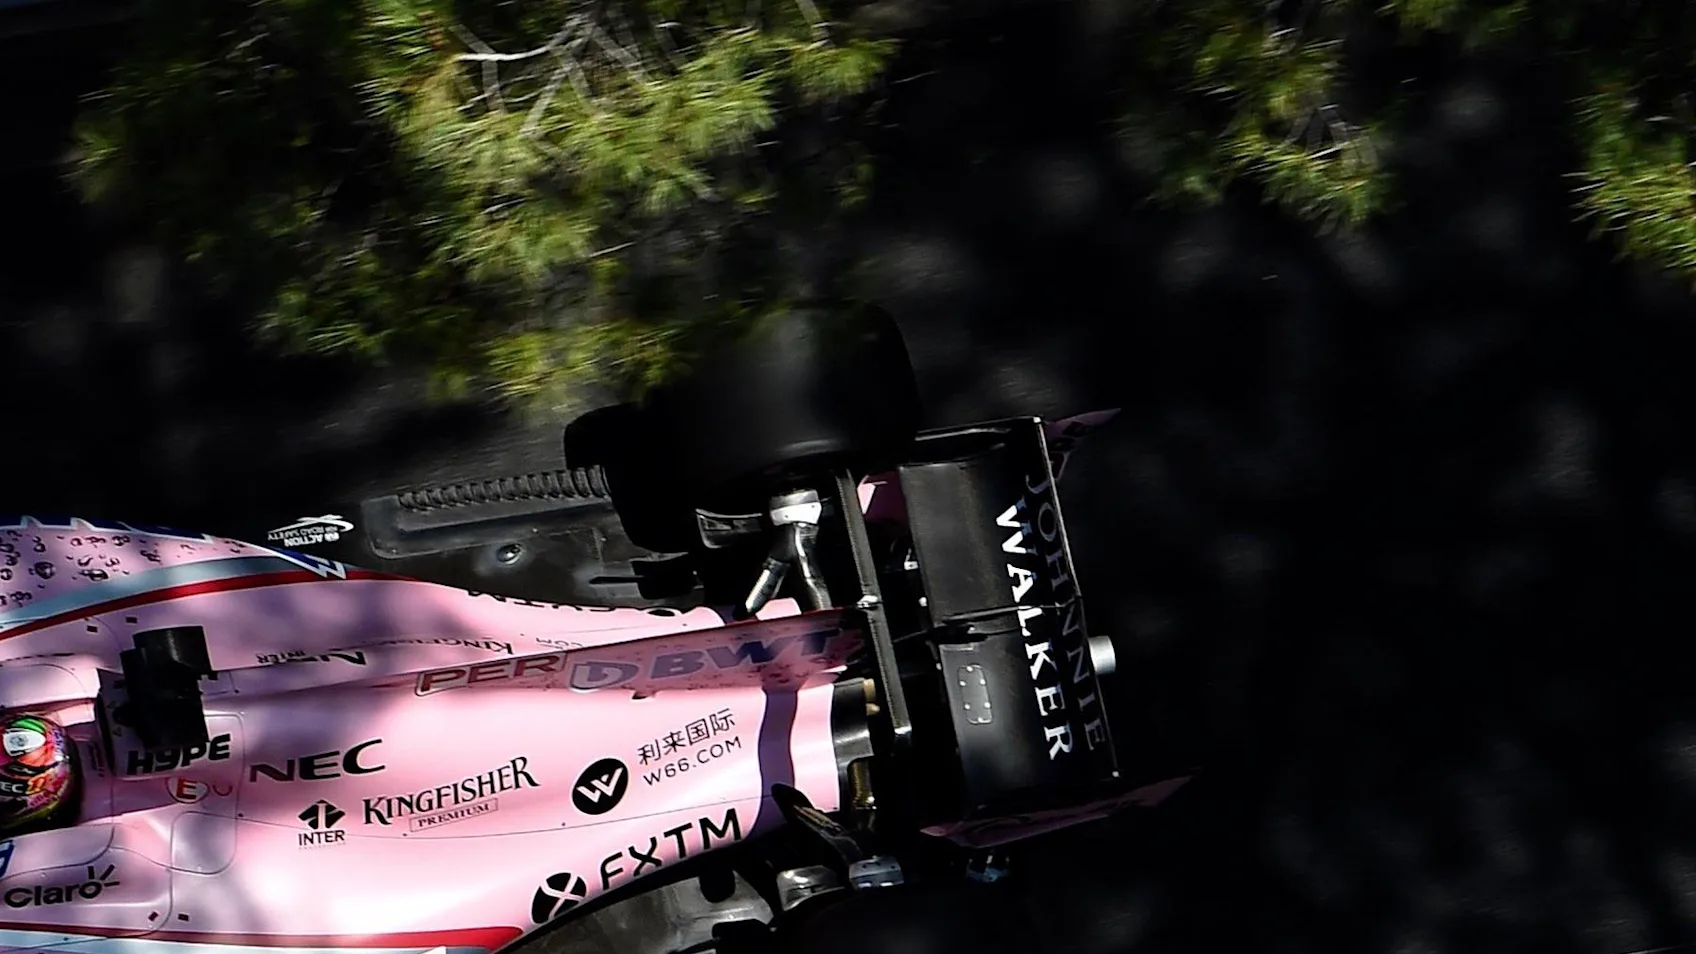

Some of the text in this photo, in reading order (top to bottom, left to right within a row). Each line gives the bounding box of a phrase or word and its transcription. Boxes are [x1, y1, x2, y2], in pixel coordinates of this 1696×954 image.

[996, 497, 1076, 760] WALKER
[1025, 465, 1107, 751] JOHNNIE
[420, 653, 564, 693] PER
[651, 628, 843, 680] BWT
[127, 733, 231, 776] HYPE
[249, 738, 386, 783] NEC
[636, 708, 737, 767] 利来国际
[642, 735, 743, 787] W66.COM
[362, 756, 541, 826] KINGFISHER
[417, 803, 490, 828] PREMIUM
[298, 829, 346, 847] INTER
[600, 808, 742, 890] FXTM
[4, 876, 106, 908] Claro
